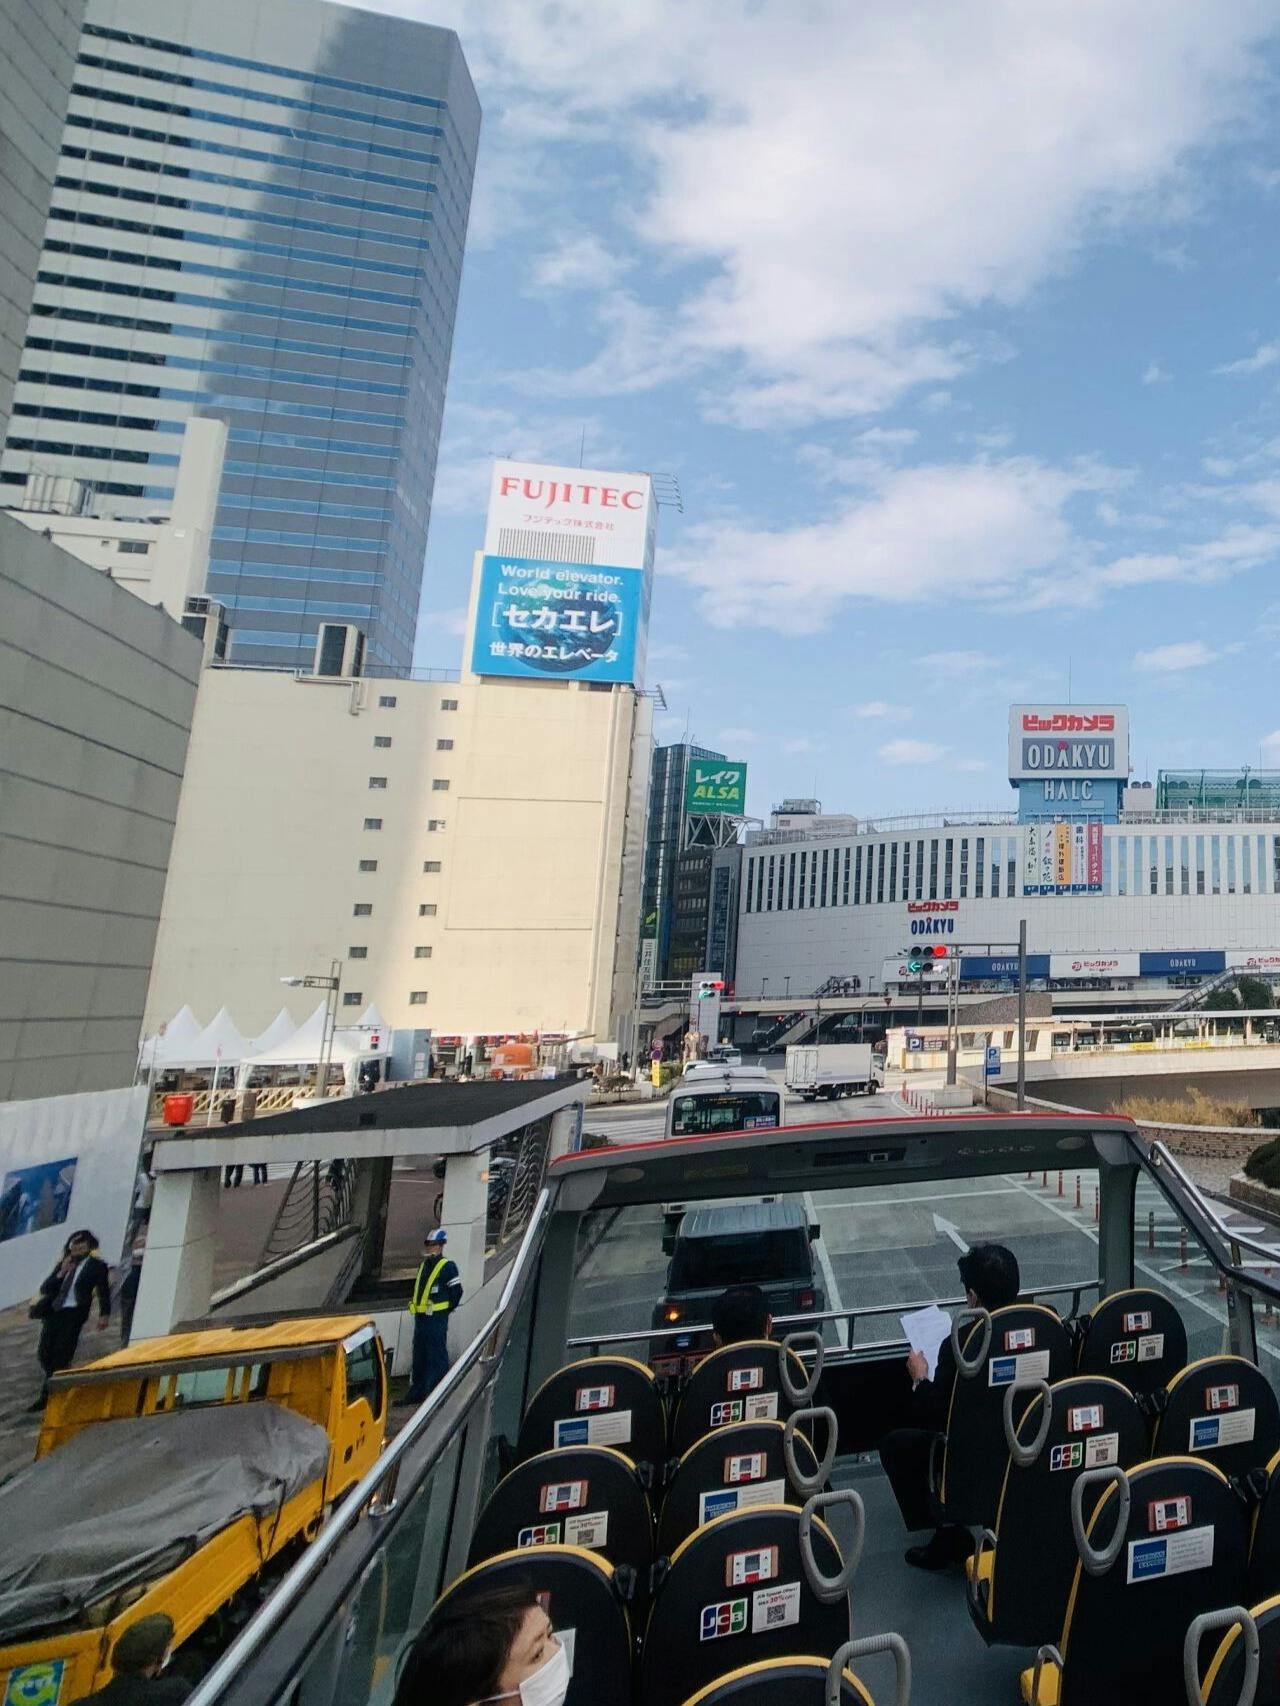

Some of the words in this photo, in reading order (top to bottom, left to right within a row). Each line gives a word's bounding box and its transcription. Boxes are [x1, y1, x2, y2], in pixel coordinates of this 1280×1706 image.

[500, 476, 645, 510] FUJITEC
[501, 564, 551, 580] World
[555, 569, 624, 586] elevator.
[498, 582, 538, 598] Love
[543, 586, 582, 601] your
[586, 589, 622, 603] ride.
[1022, 714, 1115, 731] ビックカメラ
[1027, 741, 1111, 769] ODAKYU
[695, 768, 740, 784] レイク
[693, 784, 740, 800] ALSA
[1043, 779, 1093, 801] HALC
[908, 900, 959, 913] ビックカメラ
[911, 917, 954, 935] ODAKYU
[1083, 960, 1119, 968] ビックカメラ
[1170, 958, 1196, 968] ODAKYU
